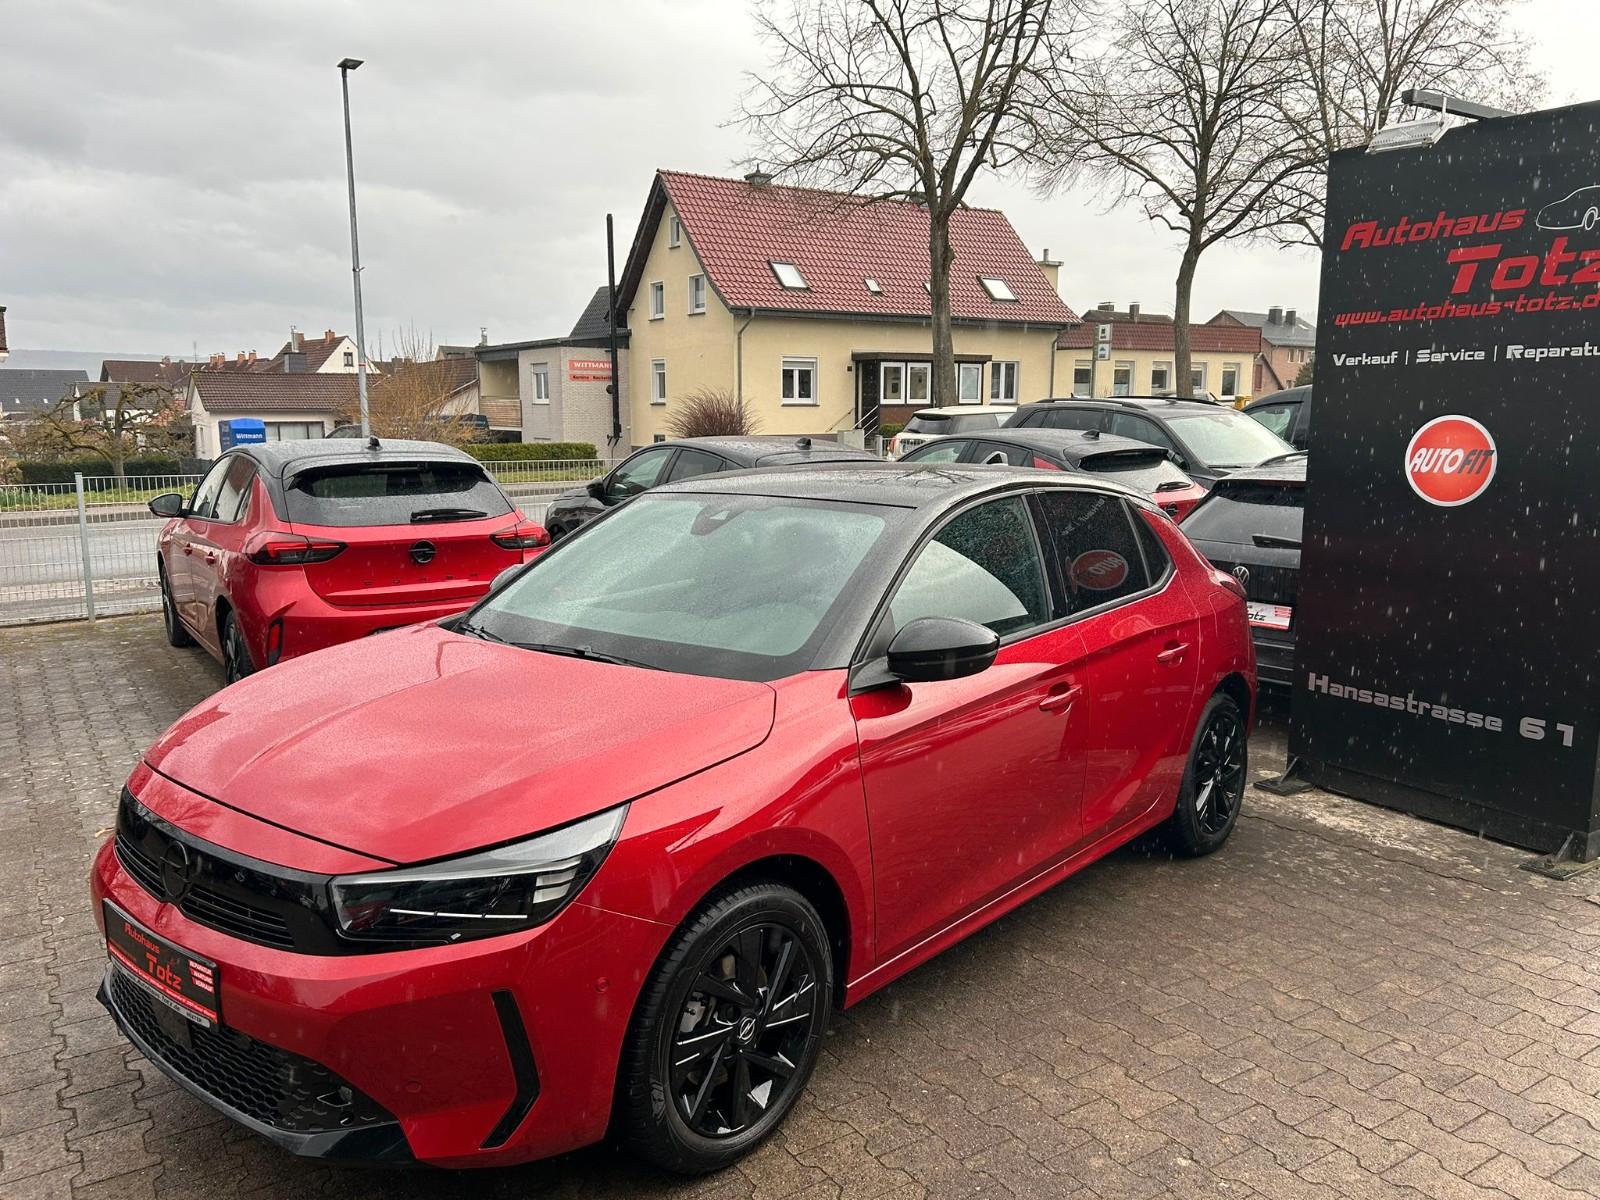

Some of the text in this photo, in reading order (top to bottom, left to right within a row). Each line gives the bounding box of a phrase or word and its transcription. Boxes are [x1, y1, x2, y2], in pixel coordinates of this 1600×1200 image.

[1340, 208, 1527, 251] Autohaus
[1446, 236, 1600, 294] Totz
[1332, 351, 1399, 367] Verkauf
[1415, 348, 1486, 364] Service
[235, 432, 263, 440] Wittmann
[1409, 447, 1495, 475] AUTOFIT
[1248, 611, 1267, 622] otz
[1307, 671, 1502, 733] Hansastrasse
[124, 921, 160, 954] Autohaus
[145, 951, 183, 990] Totz
